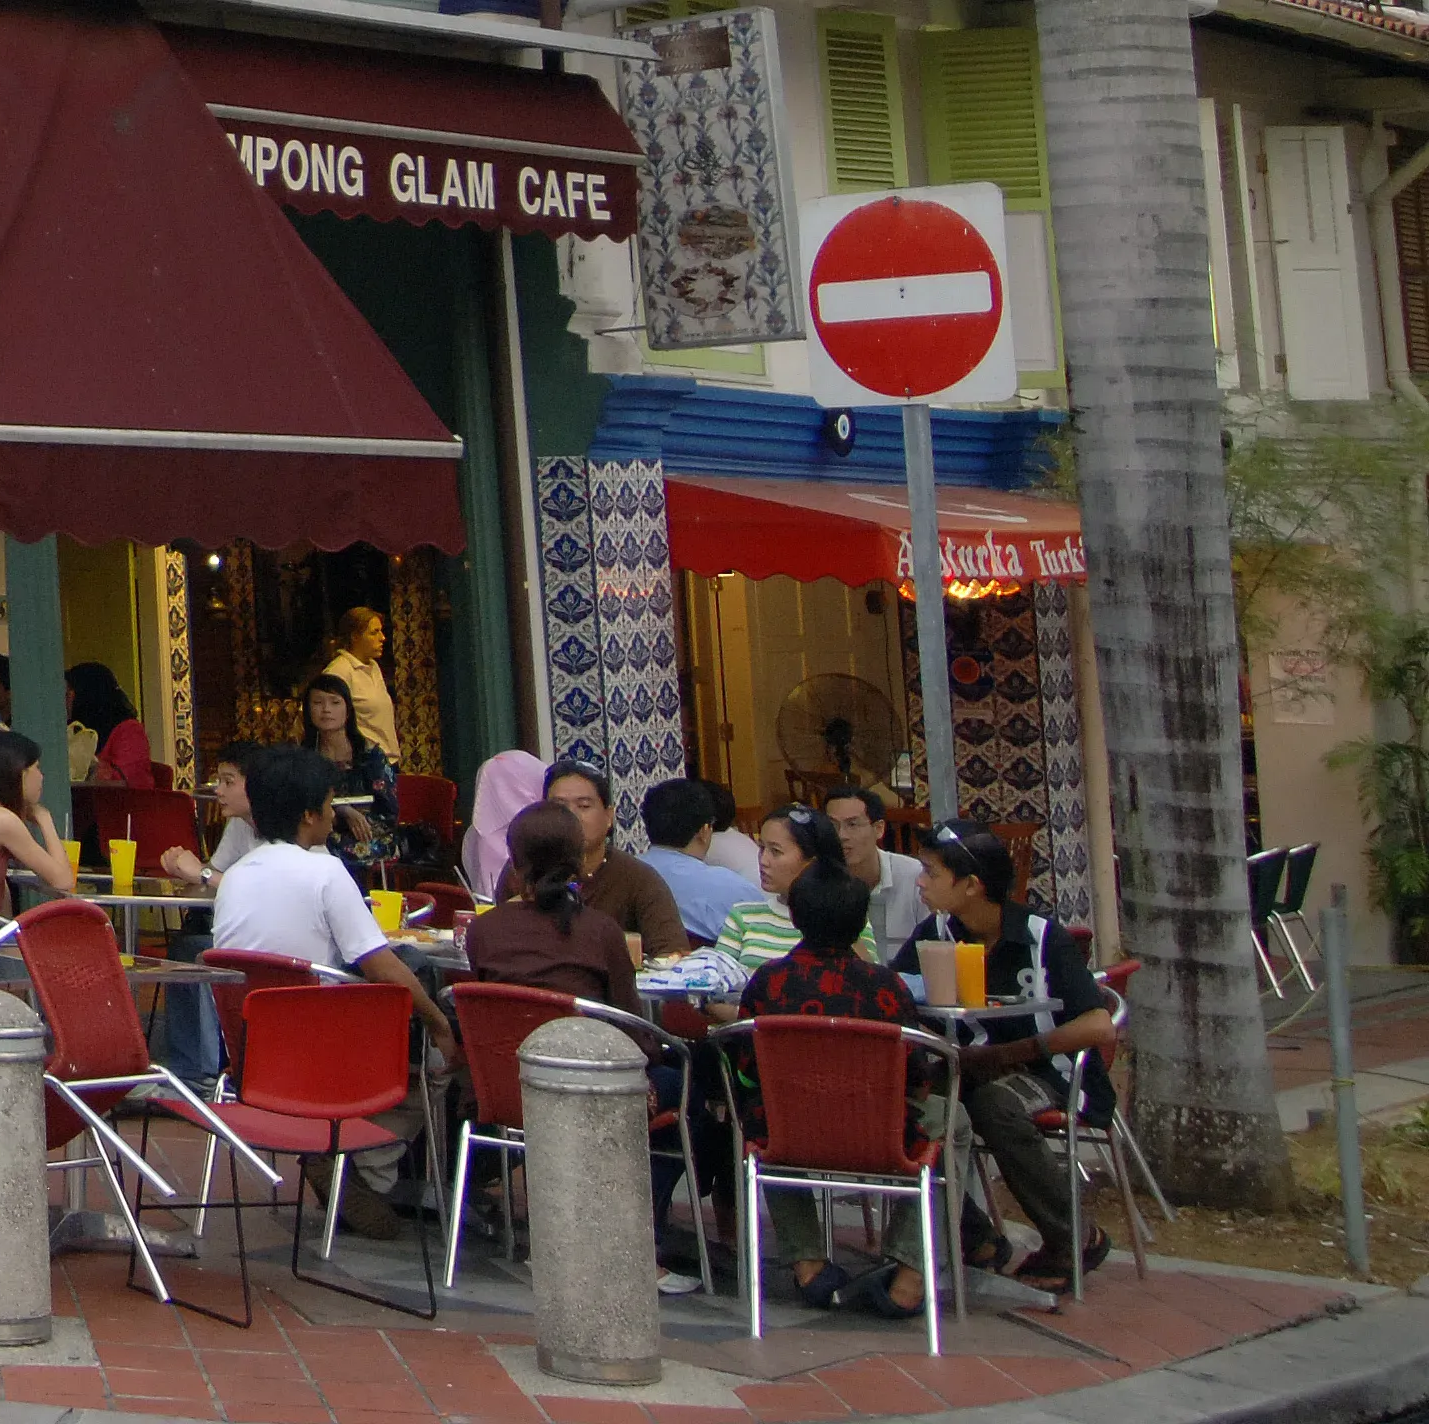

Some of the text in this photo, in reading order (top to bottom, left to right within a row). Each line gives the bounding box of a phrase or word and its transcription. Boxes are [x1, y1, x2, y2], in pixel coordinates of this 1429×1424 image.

[226, 132, 612, 221] MPONG GLAM CAFE
[897, 529, 1087, 577] Aturka Turki
